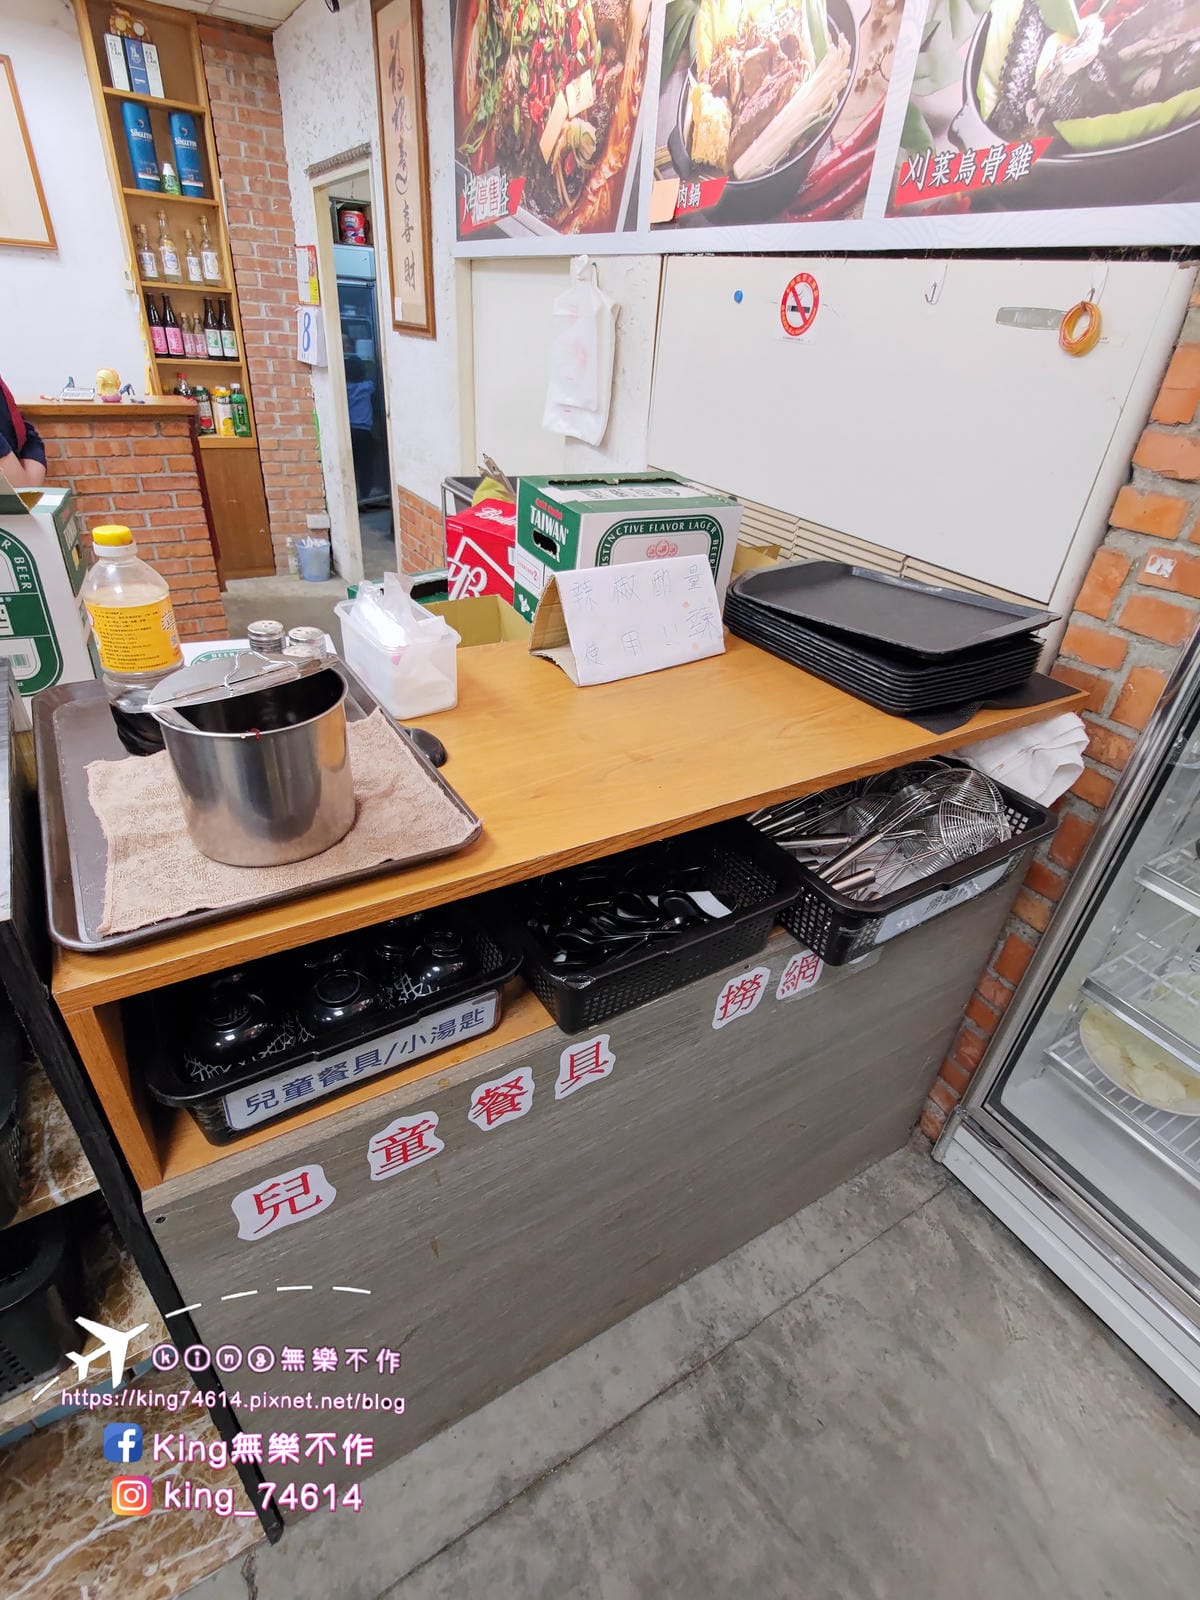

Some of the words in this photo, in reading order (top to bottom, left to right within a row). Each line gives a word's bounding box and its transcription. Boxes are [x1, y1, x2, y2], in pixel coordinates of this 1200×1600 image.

[901, 143, 1034, 192] 刈菜烏骨雞
[302, 312, 312, 352] 8
[530, 505, 566, 546] TAIWAN
[602, 523, 645, 567] ISTINCTIVE
[649, 522, 685, 532] FLAVOR
[688, 521, 718, 534] LAGER
[14, 556, 33, 590] BEER
[245, 1006, 486, 1117] 兒童餐具/小湯匙
[253, 1040, 610, 1235] 兒童餐具
